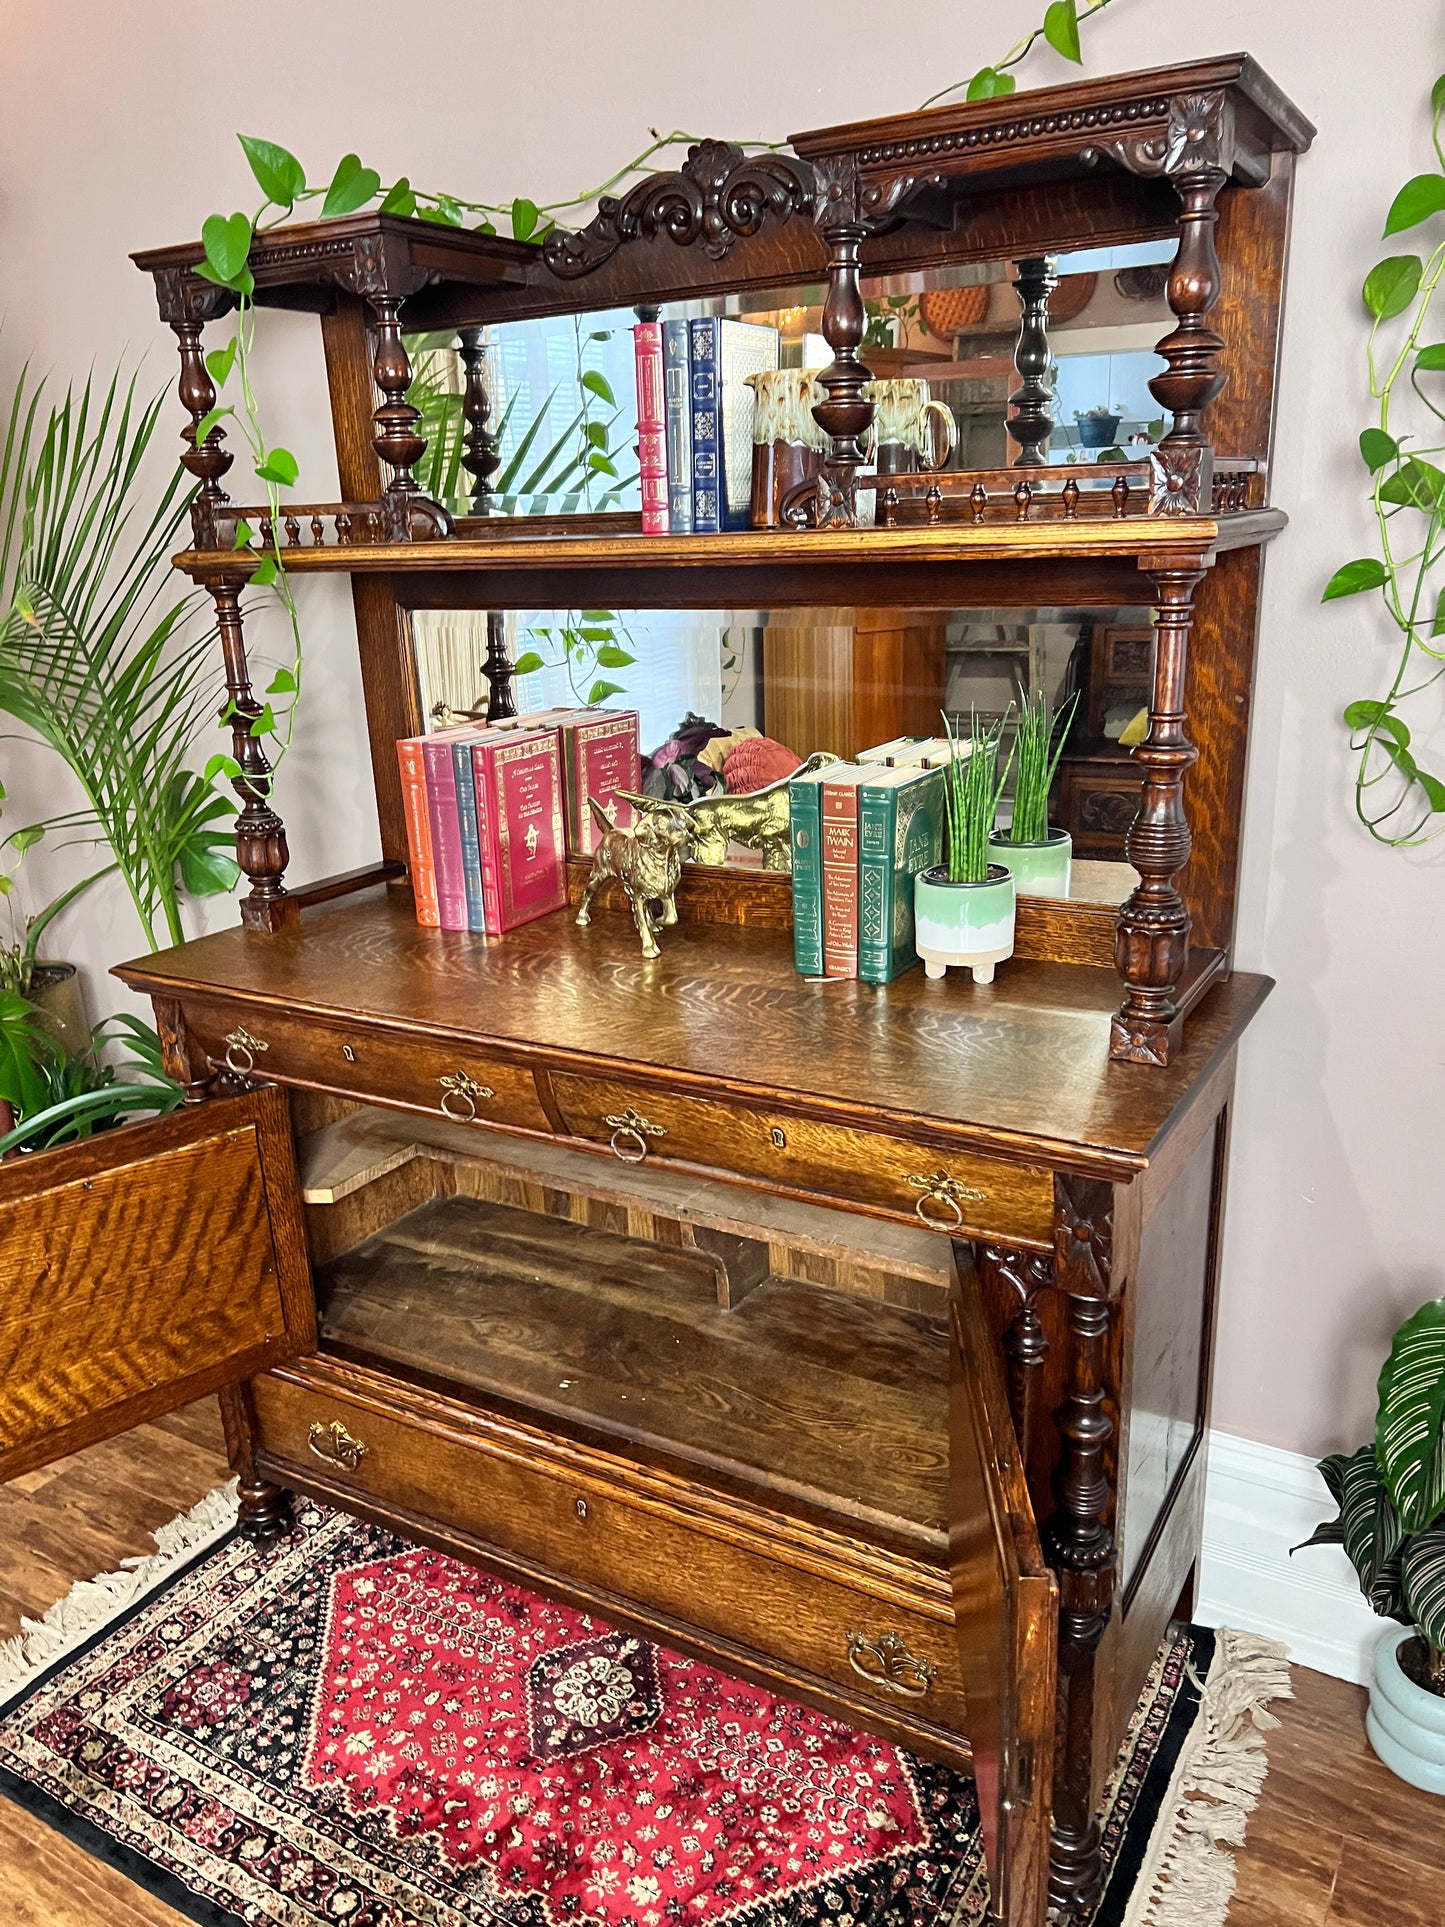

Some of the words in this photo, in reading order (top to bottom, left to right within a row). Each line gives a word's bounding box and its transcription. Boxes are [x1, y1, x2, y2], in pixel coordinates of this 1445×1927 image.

[828, 827, 850, 837] MARK
[864, 822, 883, 831] JANE
[864, 829, 883, 838] EYRE
[826, 835, 854, 848] TWAIN
[908, 832, 930, 858] JANE
[908, 850, 930, 874] EYRE
